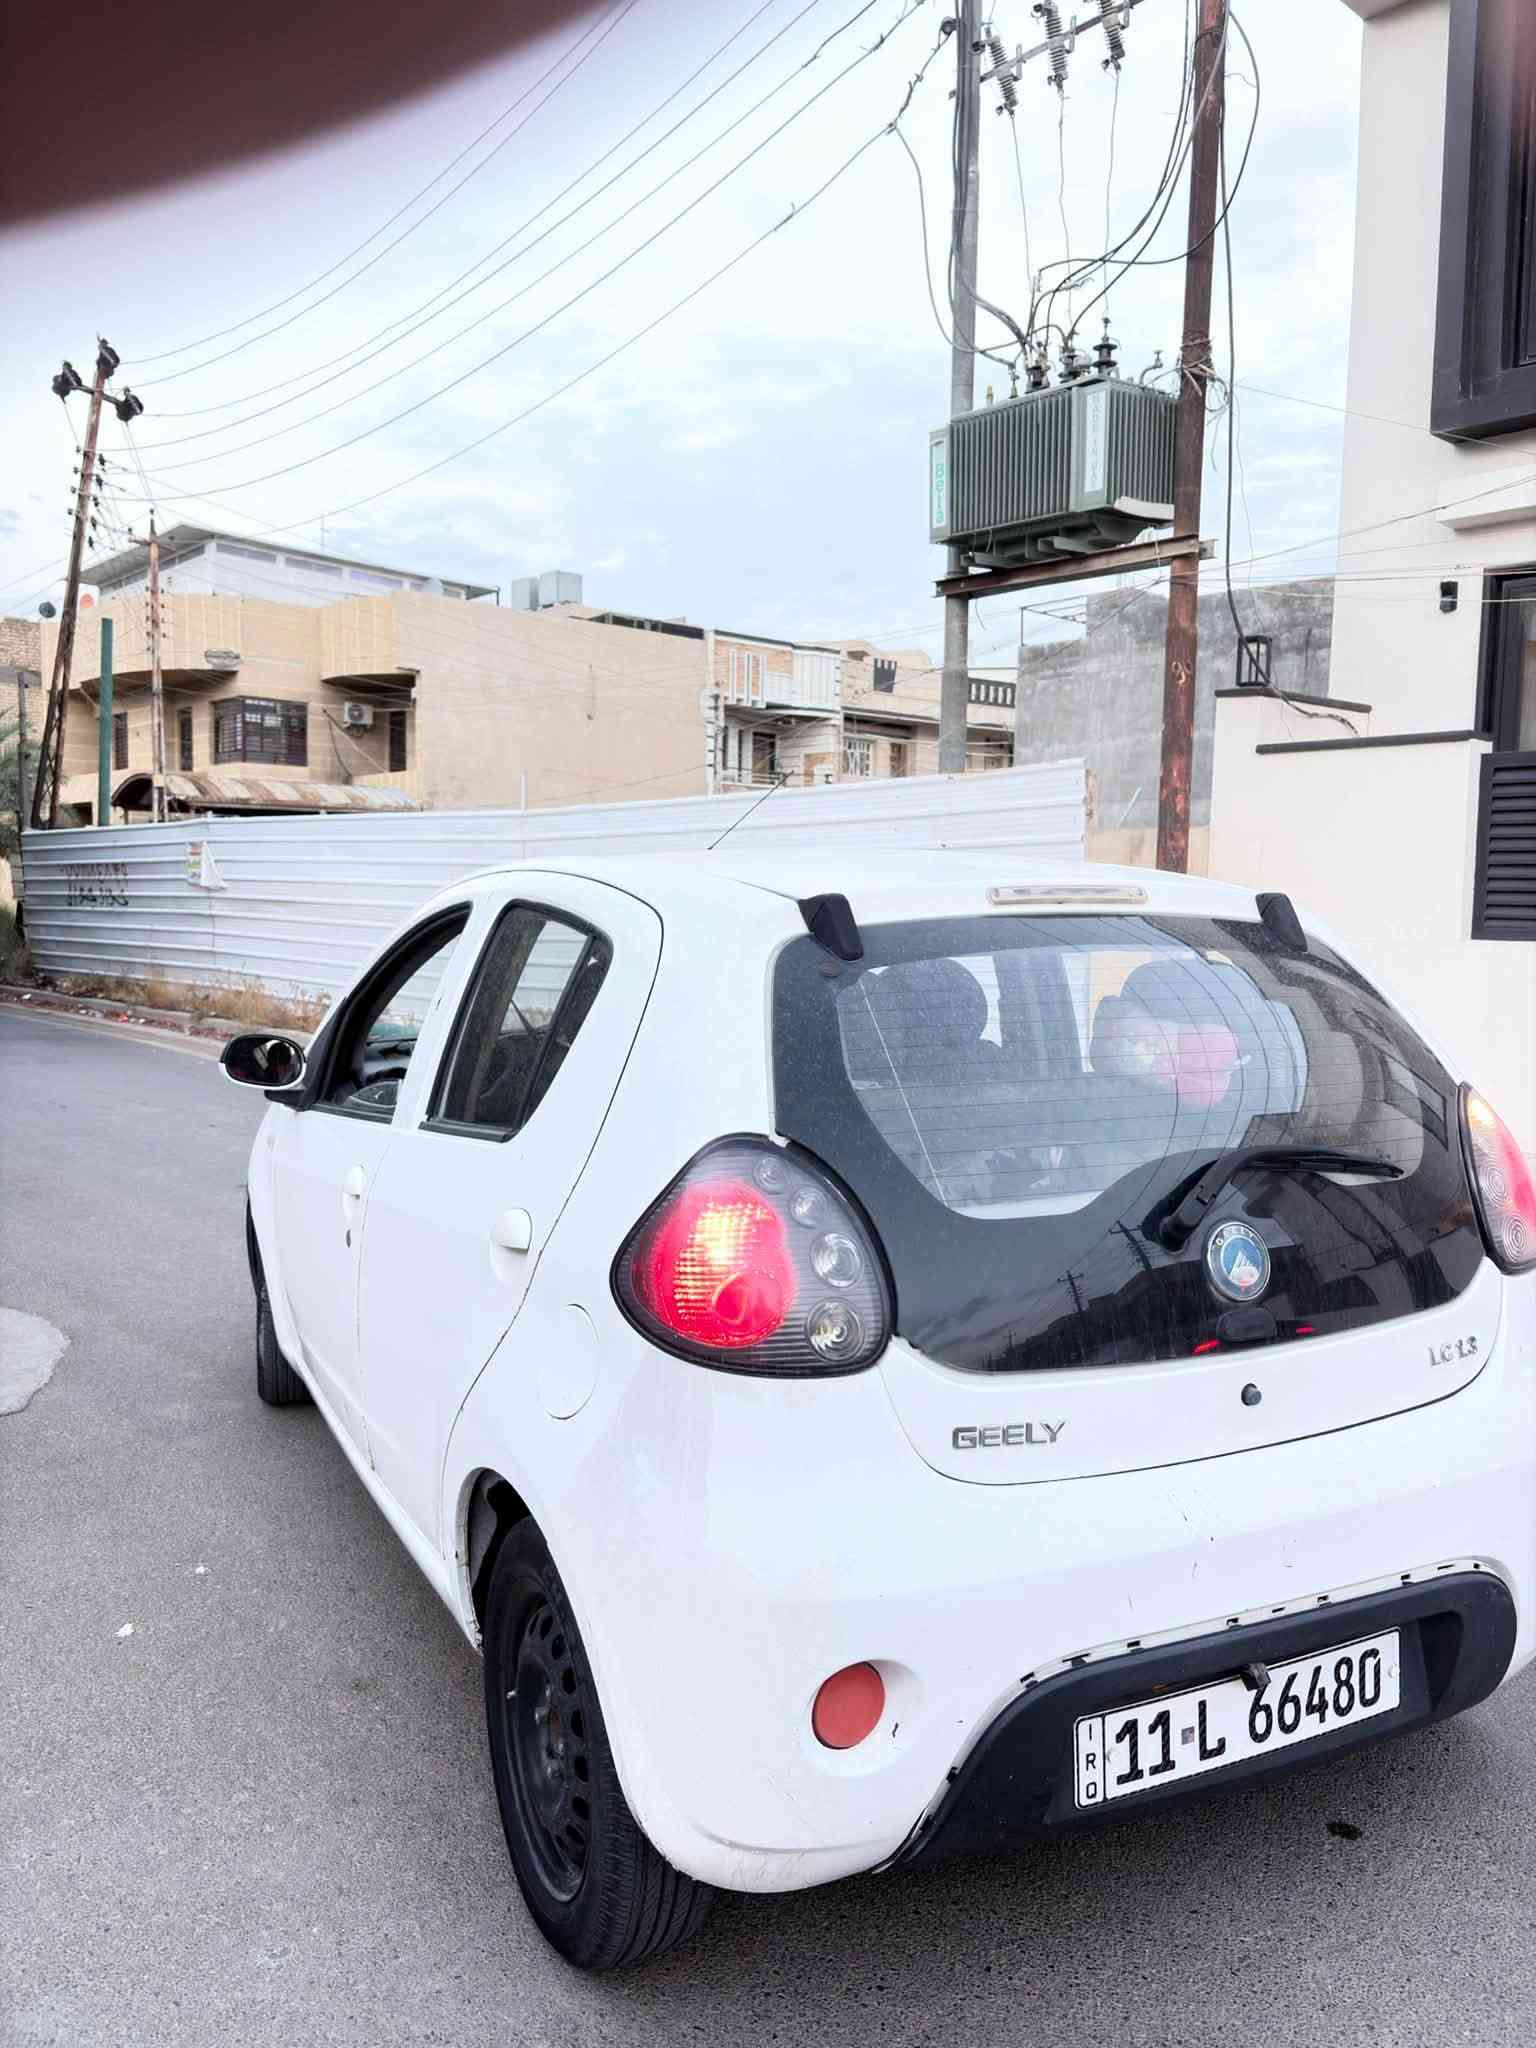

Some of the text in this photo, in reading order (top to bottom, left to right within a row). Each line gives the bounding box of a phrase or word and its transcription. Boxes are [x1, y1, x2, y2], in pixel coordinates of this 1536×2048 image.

[952, 1421, 1066, 1449] GEELY
[1115, 1648, 1382, 1785] 11 L 66480
[1085, 1723, 1098, 1800] IRQ
